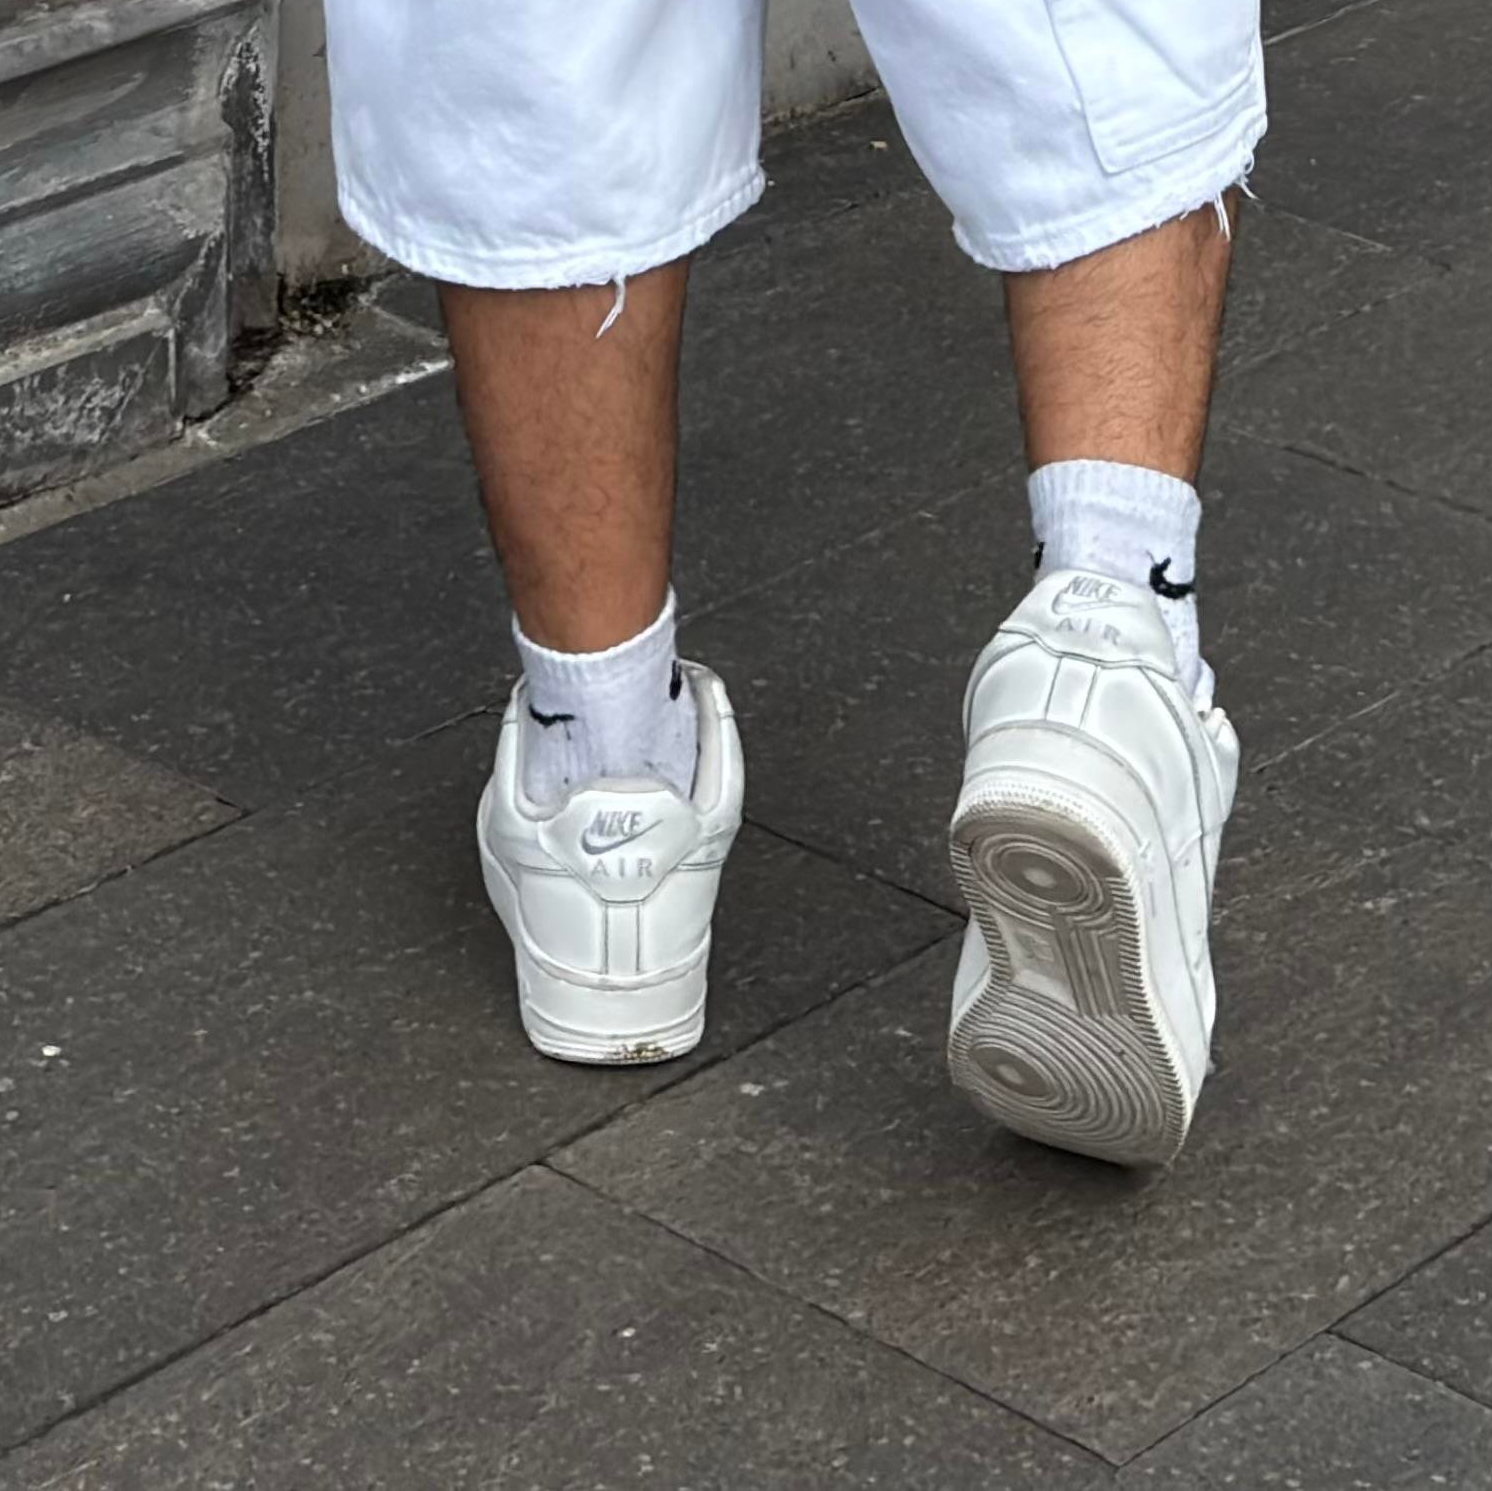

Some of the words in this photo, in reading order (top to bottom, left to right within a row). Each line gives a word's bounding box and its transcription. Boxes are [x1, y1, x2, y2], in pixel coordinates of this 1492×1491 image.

[1065, 576, 1122, 601] NIKE
[1056, 616, 1121, 645] AIR
[588, 810, 643, 837] NIKE
[590, 857, 653, 877] AIR
